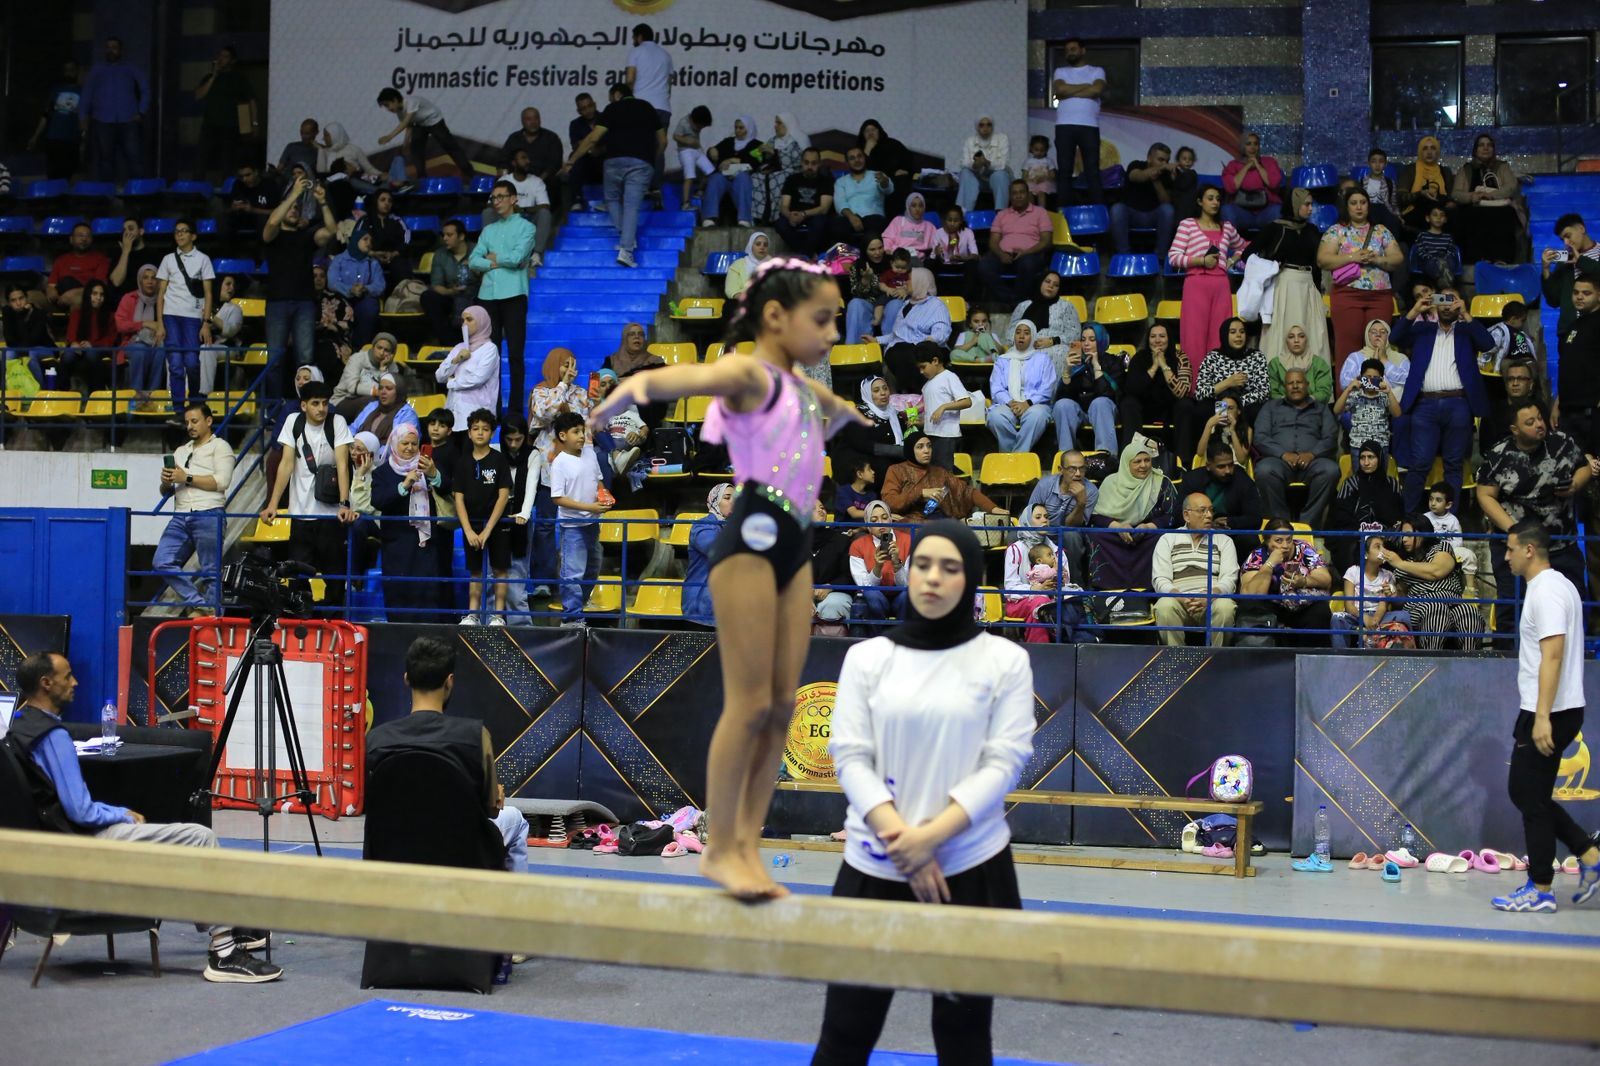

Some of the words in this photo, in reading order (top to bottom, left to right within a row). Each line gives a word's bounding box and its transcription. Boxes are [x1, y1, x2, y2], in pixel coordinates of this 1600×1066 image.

[393, 27, 487, 52] للجمباز
[754, 31, 886, 57] مهرجانات
[391, 65, 499, 95] Gymnastic
[506, 65, 598, 87] Festivals
[669, 65, 739, 87] ational
[745, 68, 886, 94] competitions
[809, 724, 831, 738] EG
[798, 763, 838, 779] Gymnastic
